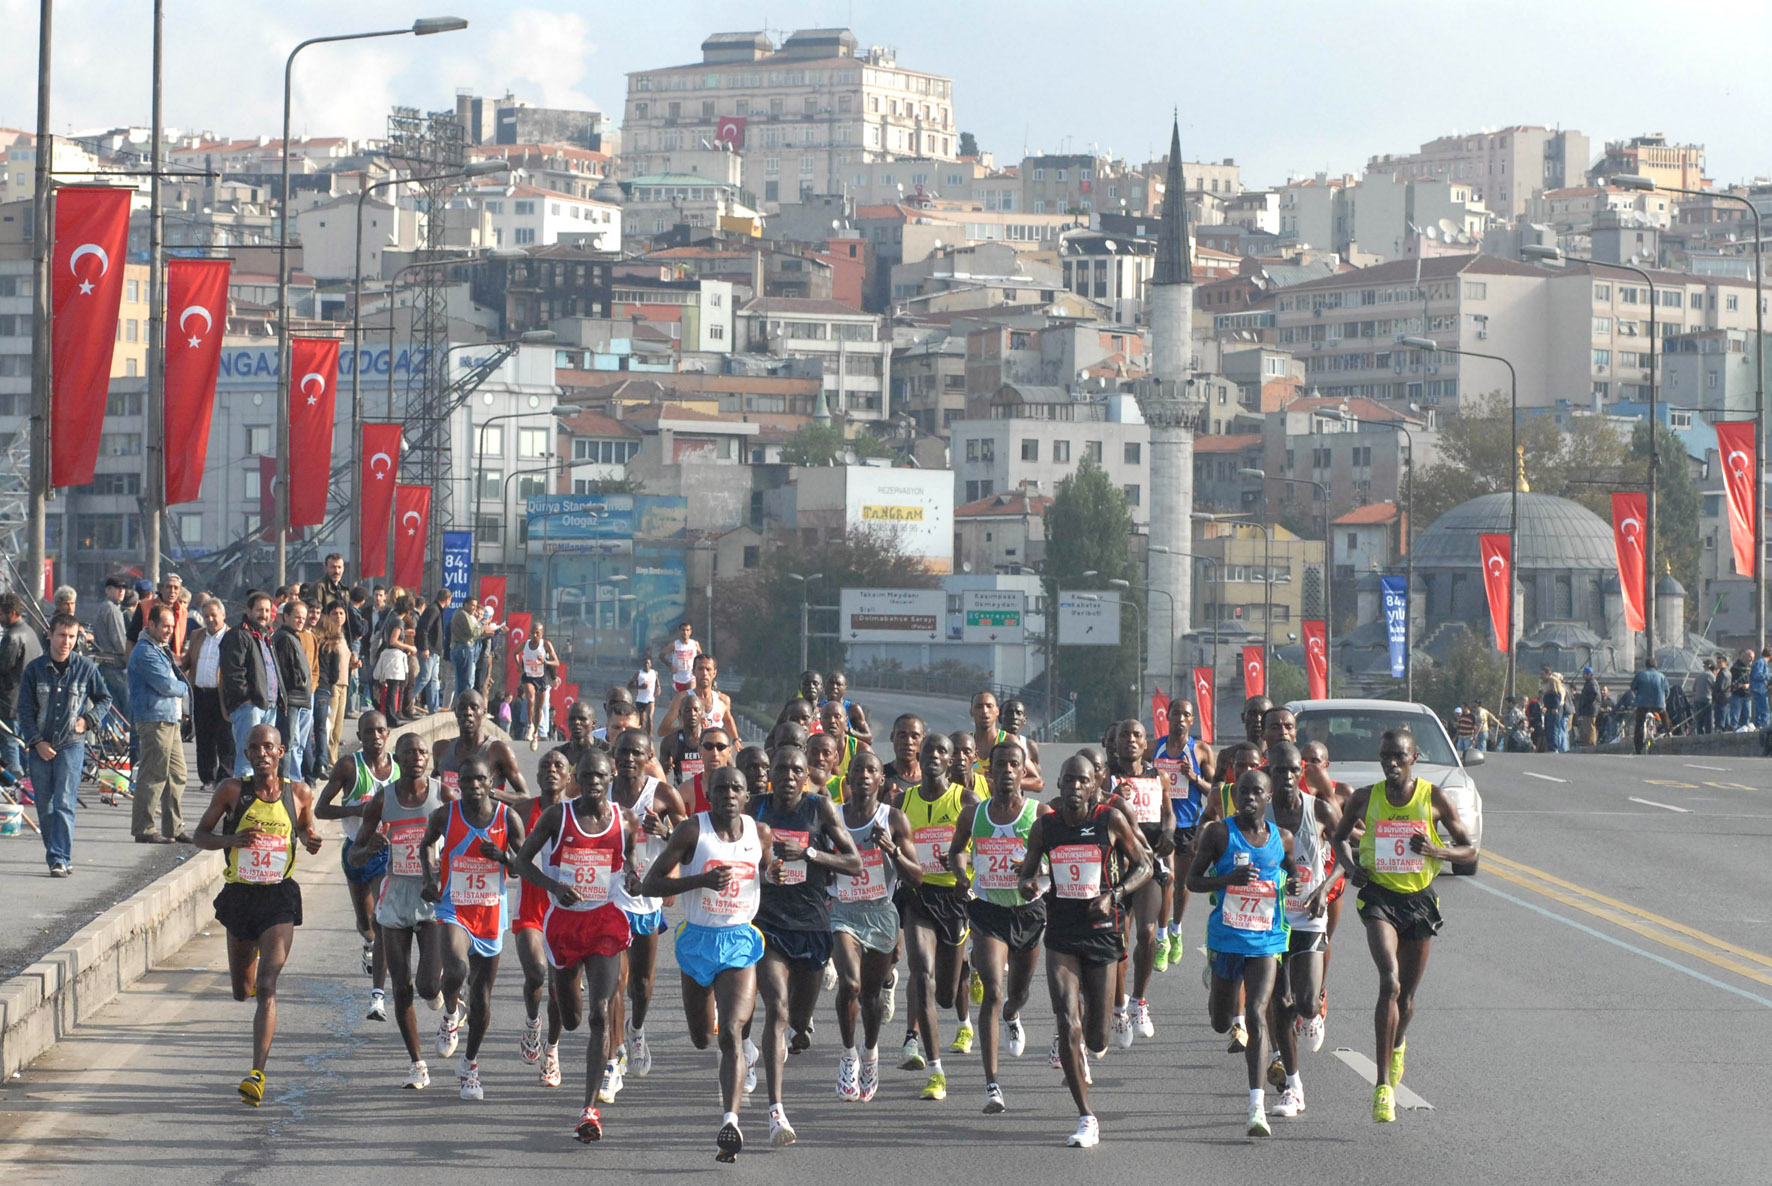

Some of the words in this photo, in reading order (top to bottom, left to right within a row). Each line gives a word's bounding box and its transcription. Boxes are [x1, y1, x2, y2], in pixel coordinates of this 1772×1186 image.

[878, 486, 924, 495] REZERVASYON
[562, 516, 598, 528] Otogaz
[445, 555, 468, 568] 84.
[444, 569, 467, 587] yılı
[1386, 595, 1404, 606] 84.
[1133, 793, 1150, 807] 40
[245, 814, 286, 828] Espira
[932, 844, 941, 859] 8
[1394, 839, 1405, 856] 6
[251, 850, 271, 868] 34
[989, 856, 1008, 873] 24
[575, 866, 596, 884] 63
[1069, 864, 1080, 881] 9
[466, 873, 486, 890] 15
[1240, 896, 1260, 913] 77
